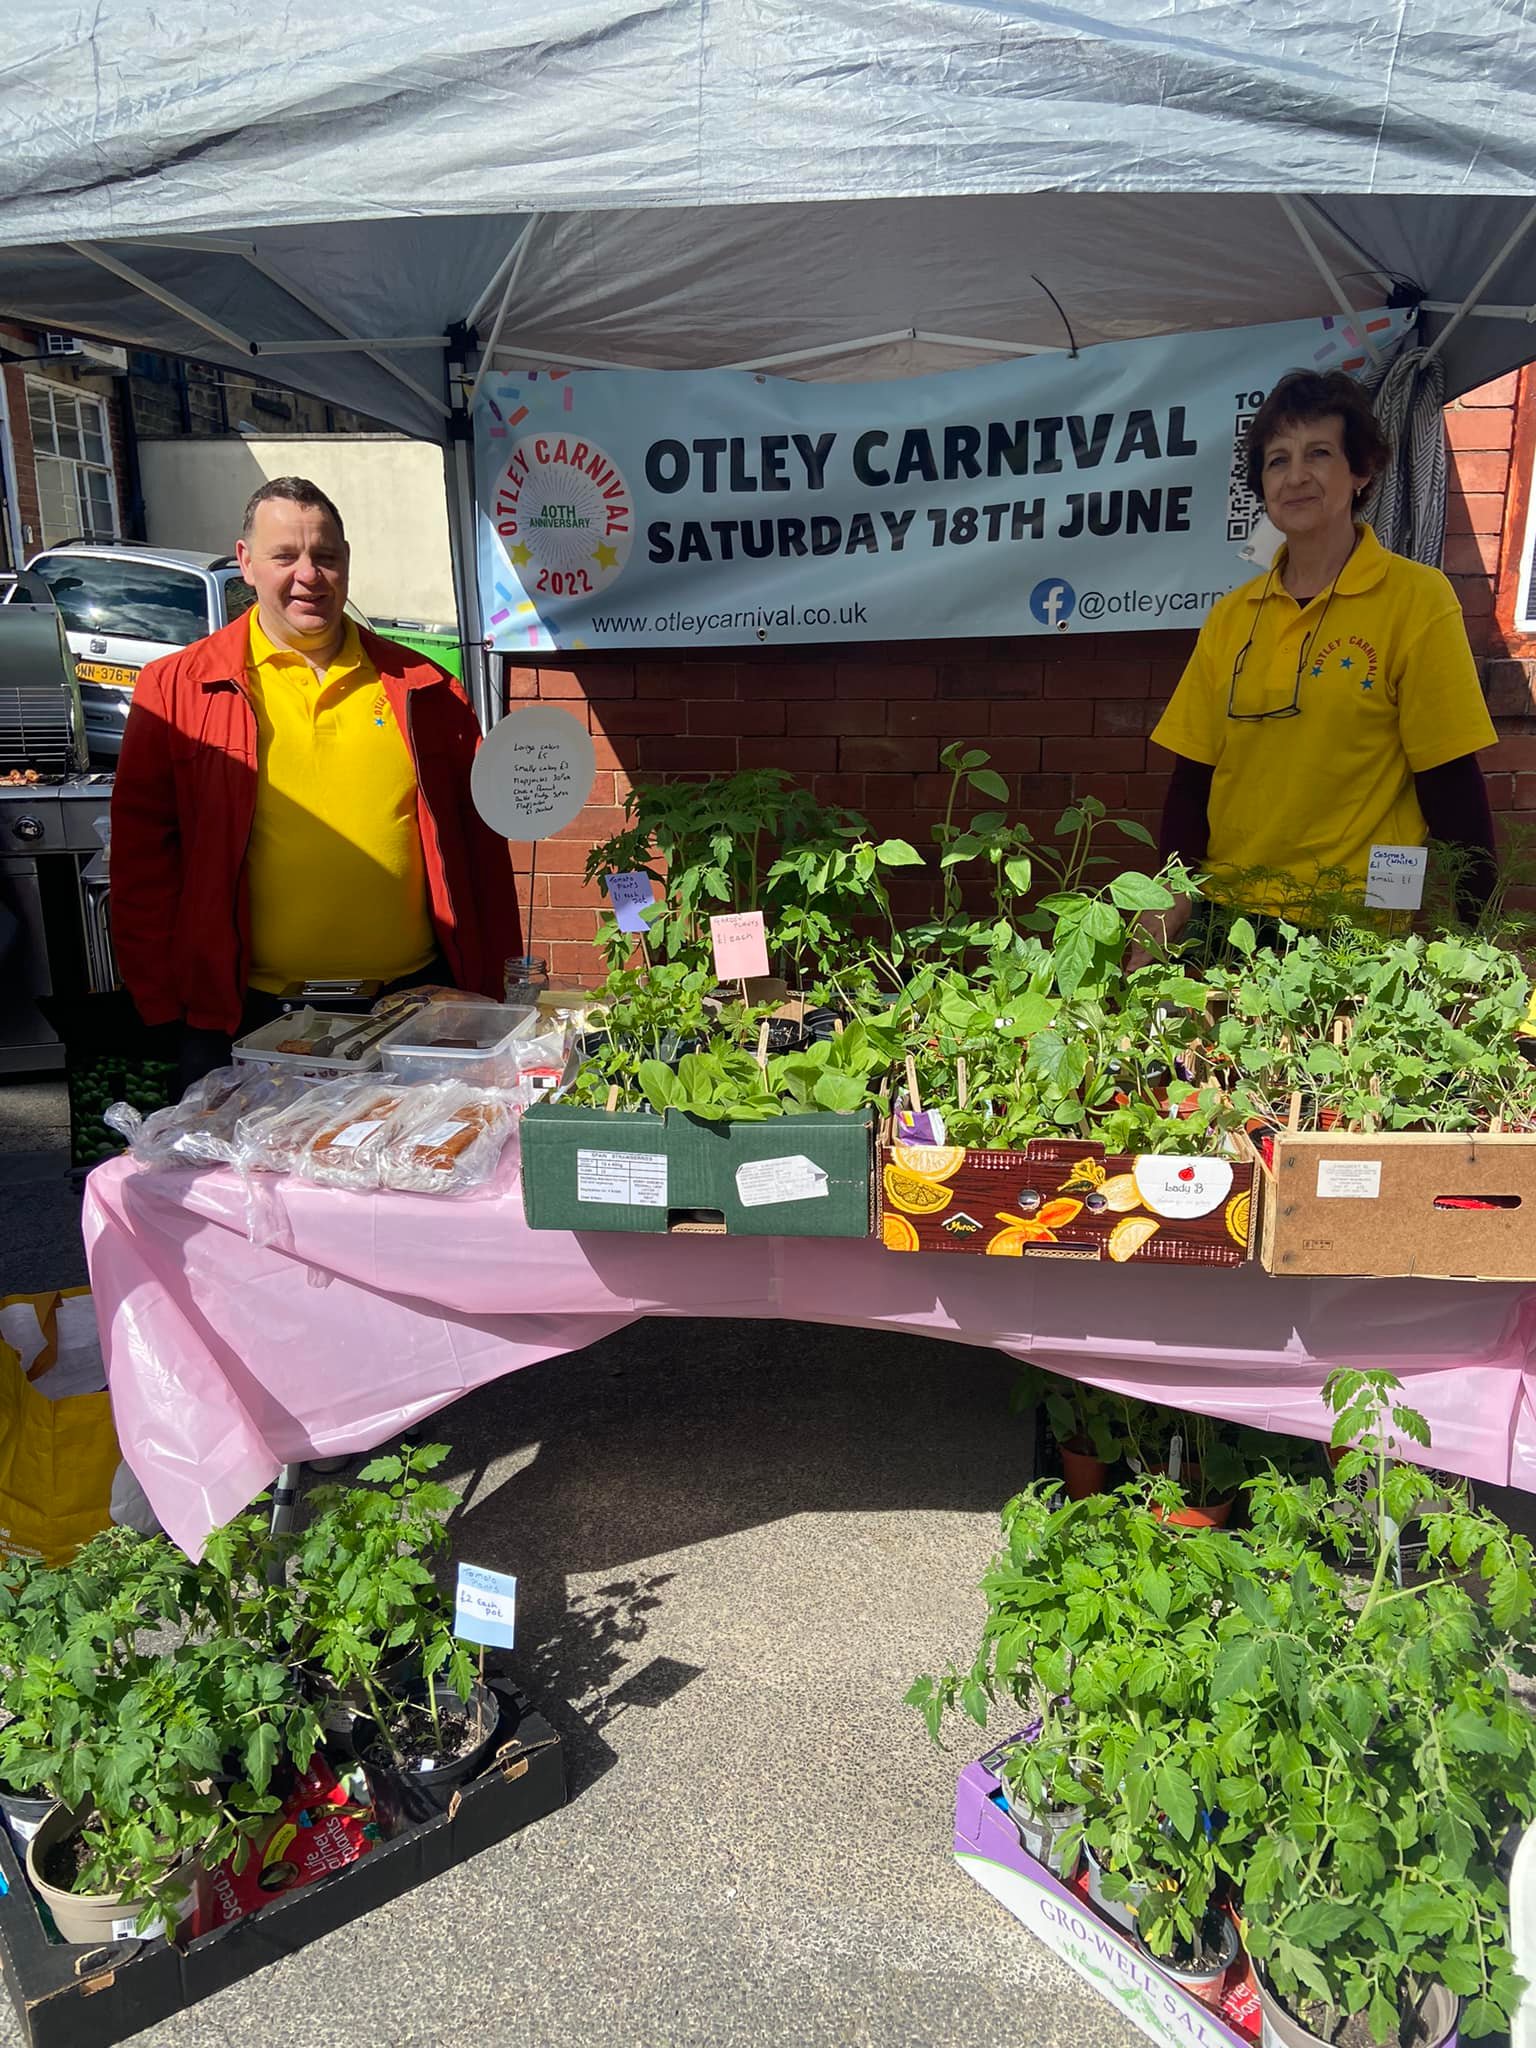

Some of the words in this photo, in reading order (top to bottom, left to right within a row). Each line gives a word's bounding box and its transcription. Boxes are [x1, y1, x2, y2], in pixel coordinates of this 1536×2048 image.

[645, 433, 837, 494] OTLEY
[852, 406, 1198, 487] CARNIVAL
[496, 448, 530, 537] OTLEY
[535, 439, 629, 536] CARNIVAL
[529, 517, 591, 529] ANNIVERSARY
[540, 504, 576, 518] 40TH
[647, 508, 916, 564] SATURDAY
[927, 498, 1047, 546] 18TH
[1058, 486, 1193, 539] JUNE
[536, 567, 594, 595] 2022
[592, 602, 868, 635] www.otleycarnival.co.uk
[1315, 638, 1341, 667] OTLEY
[1349, 635, 1378, 679] CARNIVAL
[1165, 1182, 1191, 1194] Lady
[1194, 1183, 1204, 1194] B
[304, 1852, 327, 1876] Life
[312, 1832, 341, 1872] artner
[214, 1879, 243, 1921] Seed
[1040, 1898, 1158, 1998] GRO-WELL
[1163, 1993, 1213, 2048] SAL
